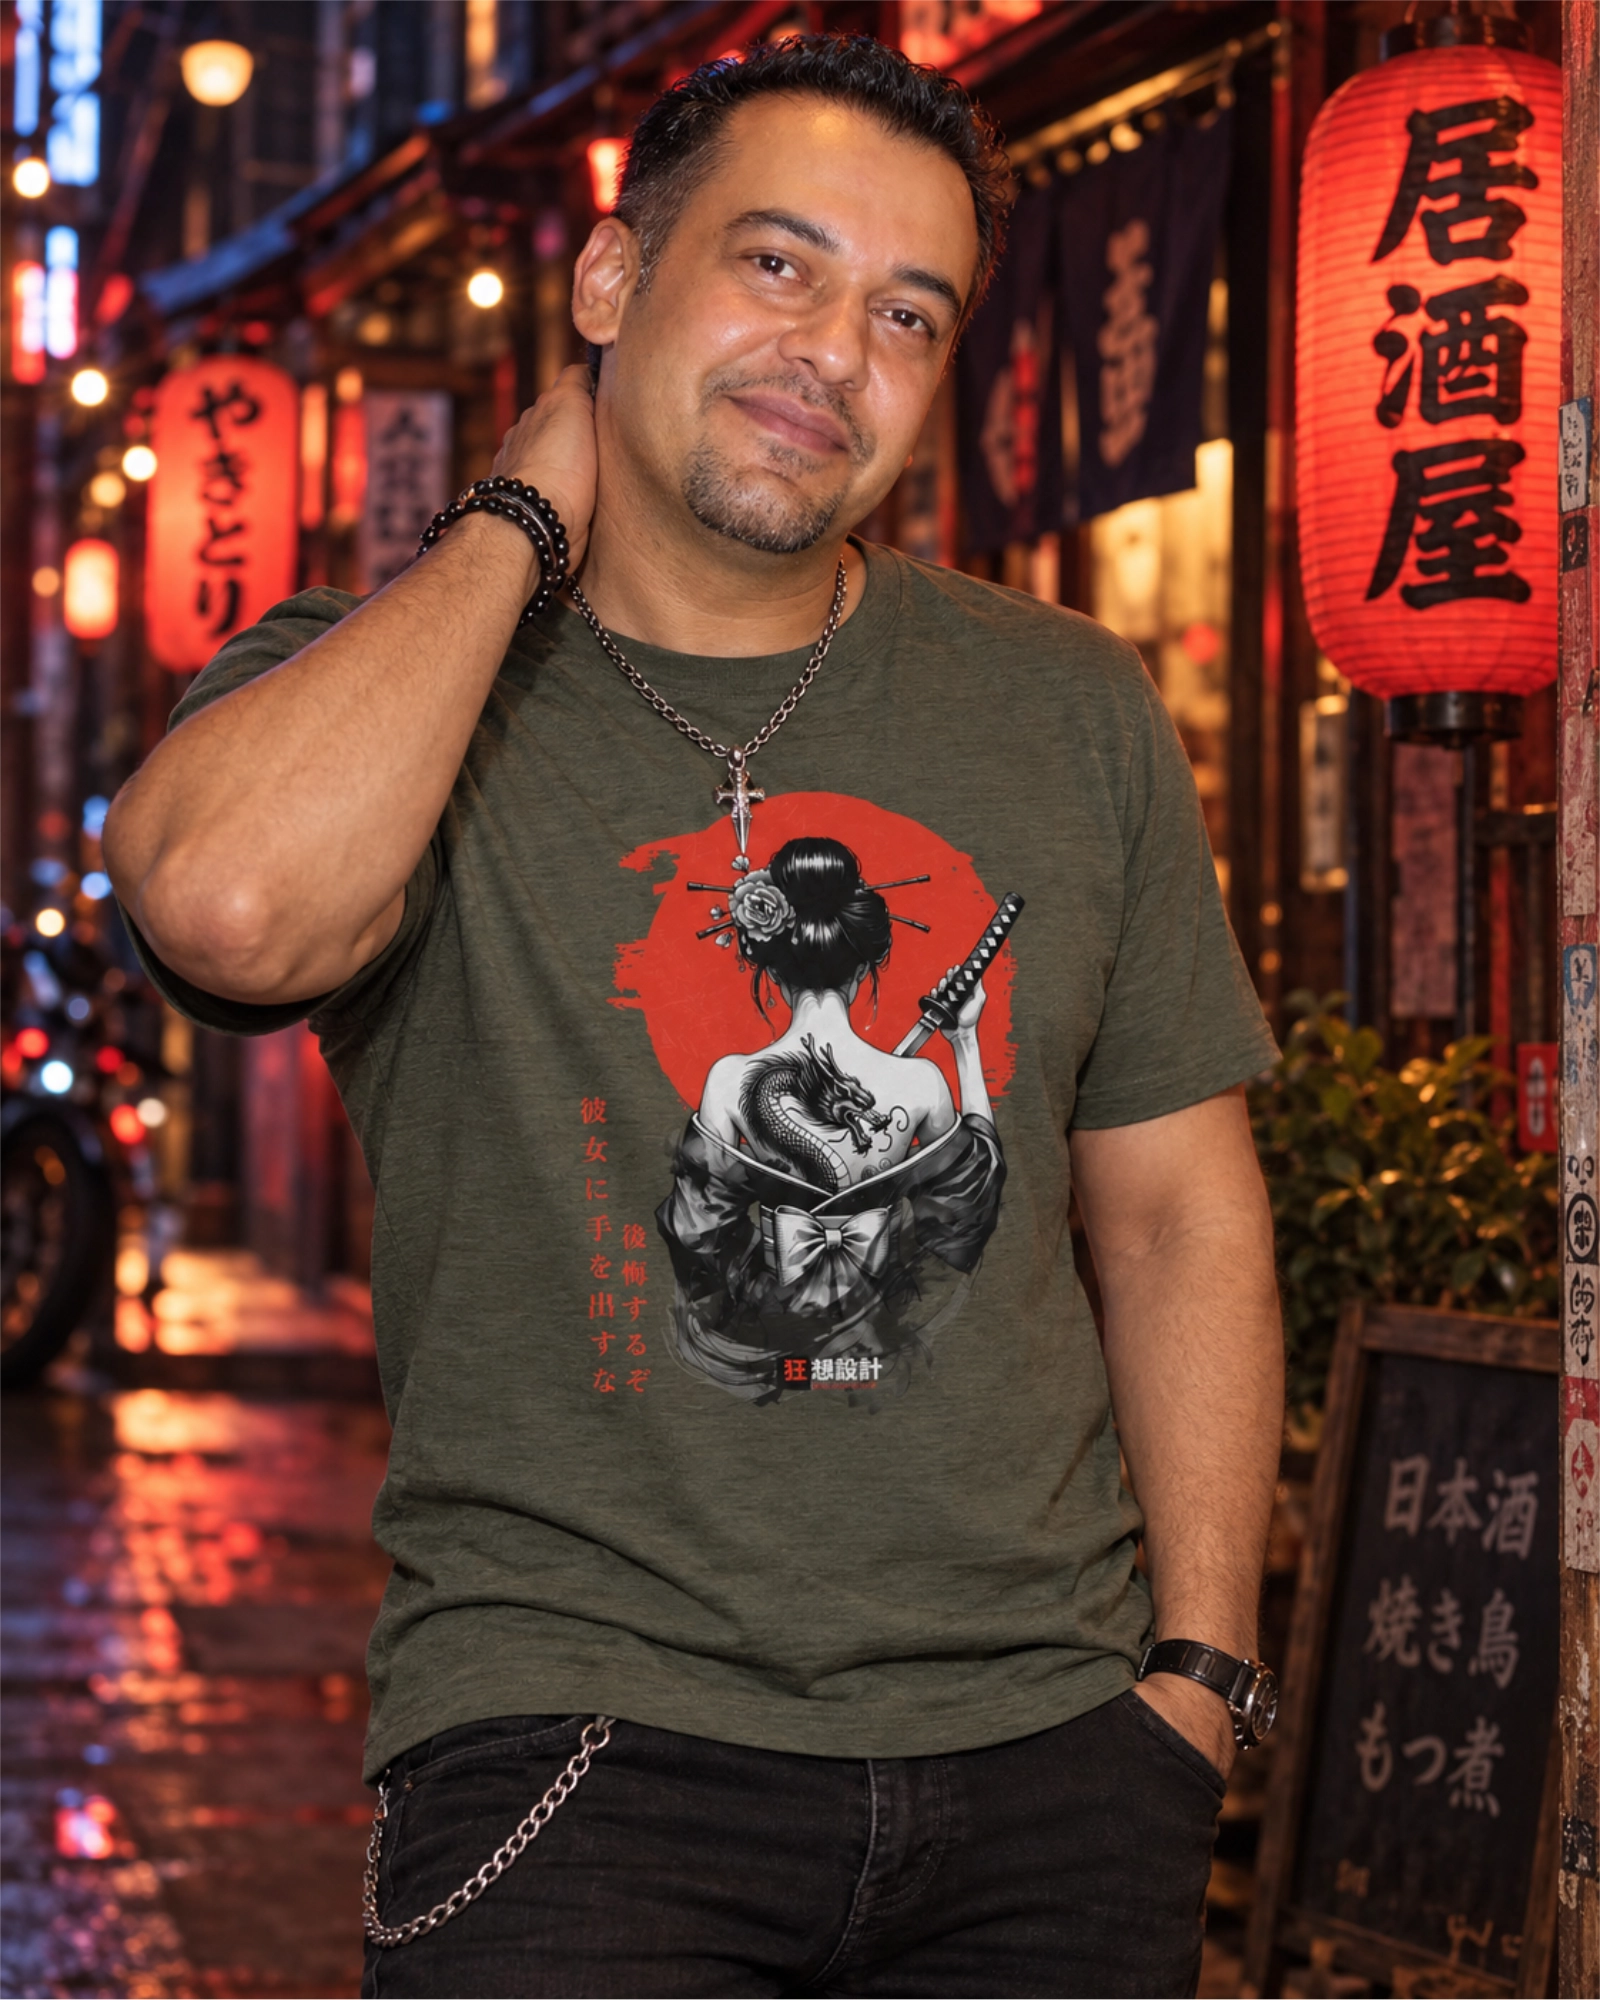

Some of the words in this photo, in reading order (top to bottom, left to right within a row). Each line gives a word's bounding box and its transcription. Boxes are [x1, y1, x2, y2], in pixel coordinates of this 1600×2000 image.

[1368, 95, 1538, 610] 居酒屋
[191, 382, 261, 636] やきとり
[581, 1098, 616, 1393] 彼女に手を出すな
[622, 1224, 650, 1393] 後悔するぞ
[784, 1357, 883, 1382] 狂想設計
[1384, 1455, 1538, 1559] 日本酒
[1365, 1577, 1519, 1688] 焼き鳥
[1356, 1703, 1504, 1817] もつ煮
